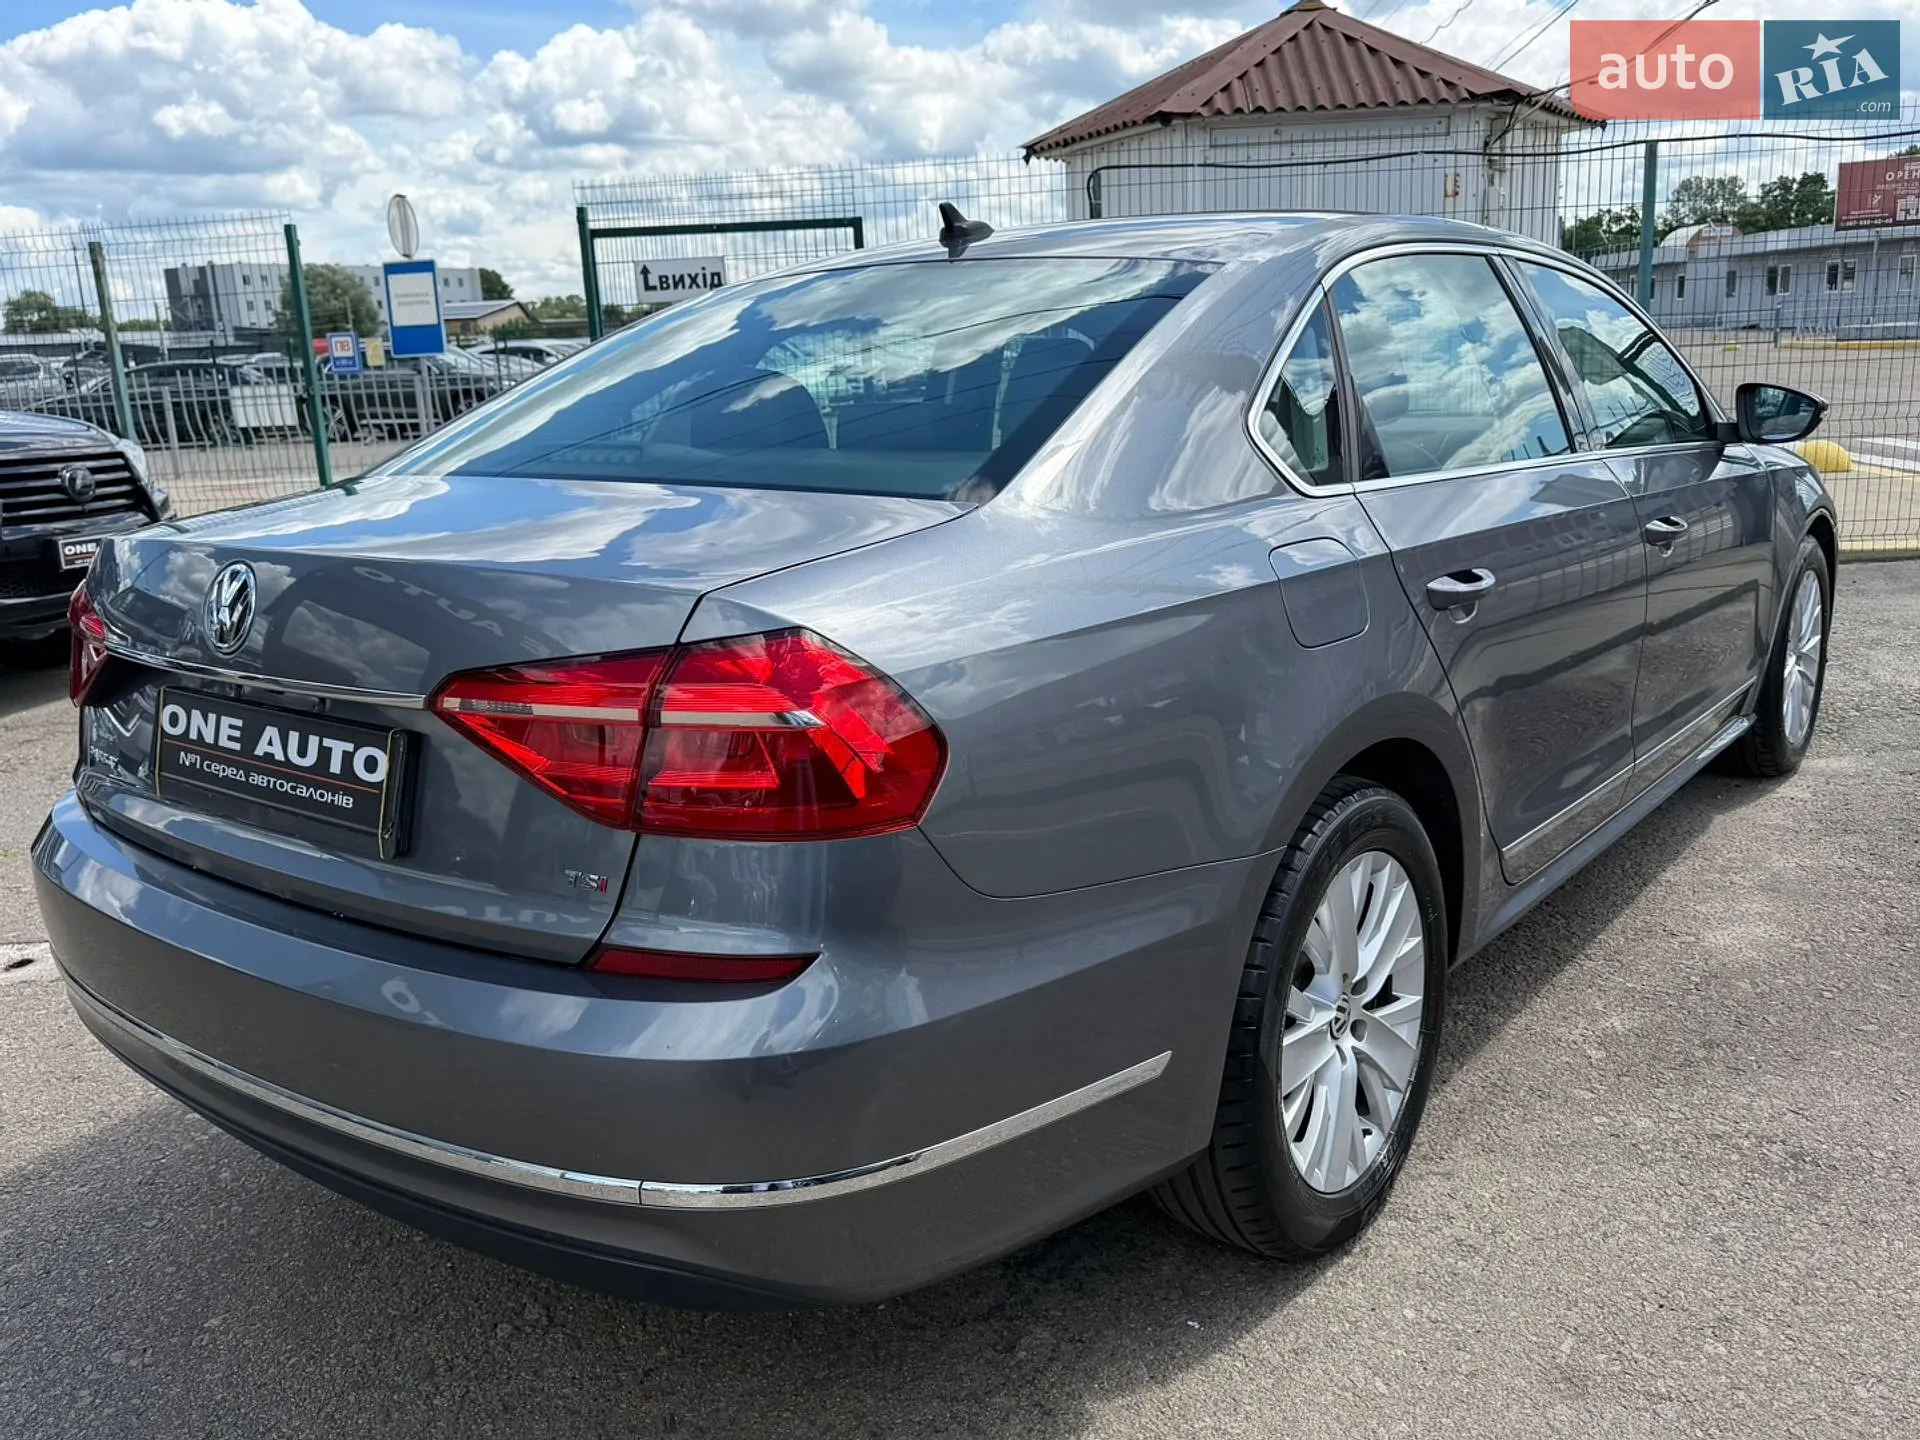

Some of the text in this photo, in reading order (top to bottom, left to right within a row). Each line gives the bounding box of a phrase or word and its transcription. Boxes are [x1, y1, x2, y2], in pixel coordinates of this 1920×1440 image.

[658, 266, 723, 291] вихід
[64, 542, 97, 555] ONE
[162, 704, 389, 783] ONE AUTO
[203, 759, 246, 782] серед
[249, 772, 354, 808] автосалонів
[565, 869, 608, 896] TSI
